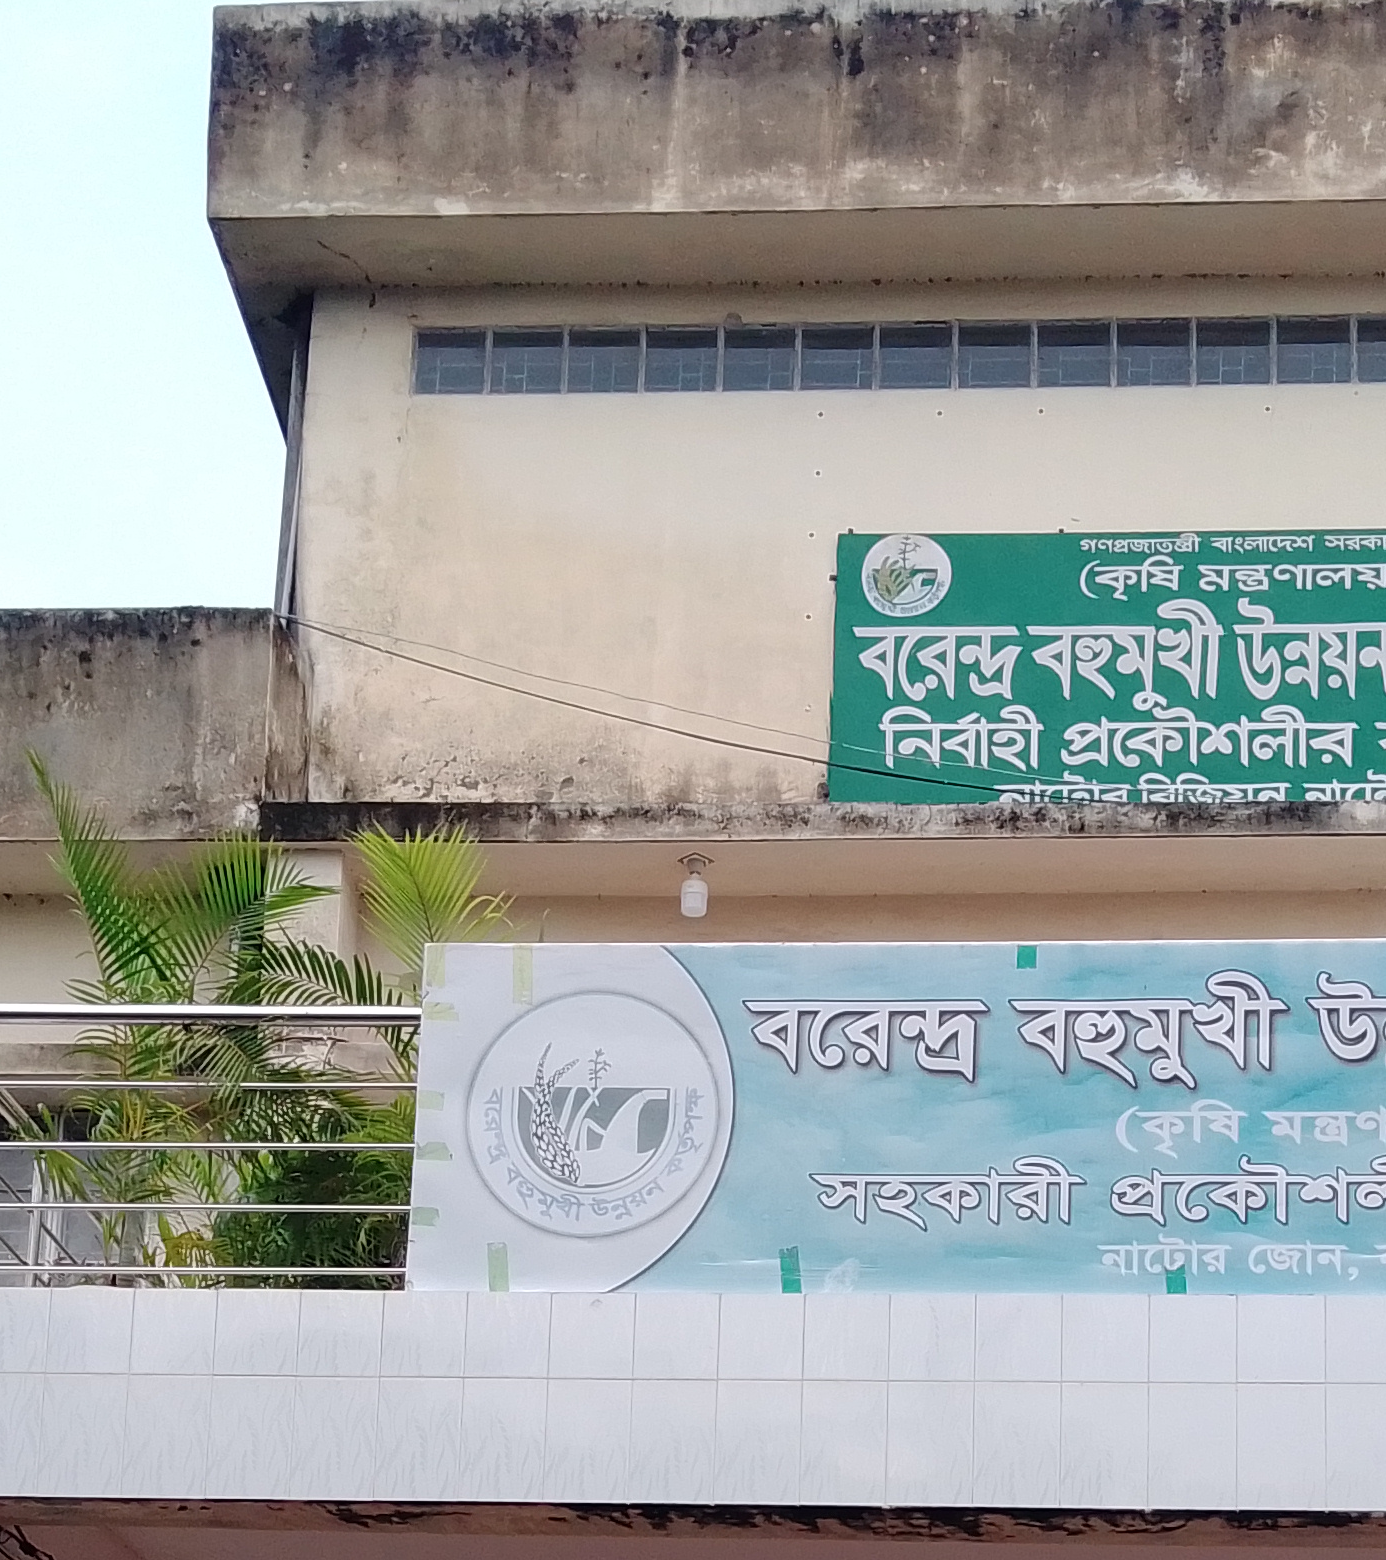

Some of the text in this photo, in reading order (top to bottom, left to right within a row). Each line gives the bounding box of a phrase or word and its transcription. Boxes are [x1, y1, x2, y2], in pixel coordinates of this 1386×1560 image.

[1210, 535, 1316, 553] বাংলাদেশ
[1079, 555, 1185, 601] (কৃষি
[852, 625, 1024, 702] বরেন্দ্র
[1025, 598, 1226, 712] বহুমুখী
[877, 704, 1045, 772] নির্বাহী
[1060, 704, 1361, 769] প্রকৌশলীর
[740, 998, 990, 1082] বরেন্দ্র
[1008, 969, 1290, 1090] বহুমুখী
[1114, 1098, 1249, 1159] (কৃষি
[808, 1155, 1087, 1232] সহকারী
[1096, 1233, 1233, 1277] নাটোর
[1247, 1238, 1361, 1282] জোন,
